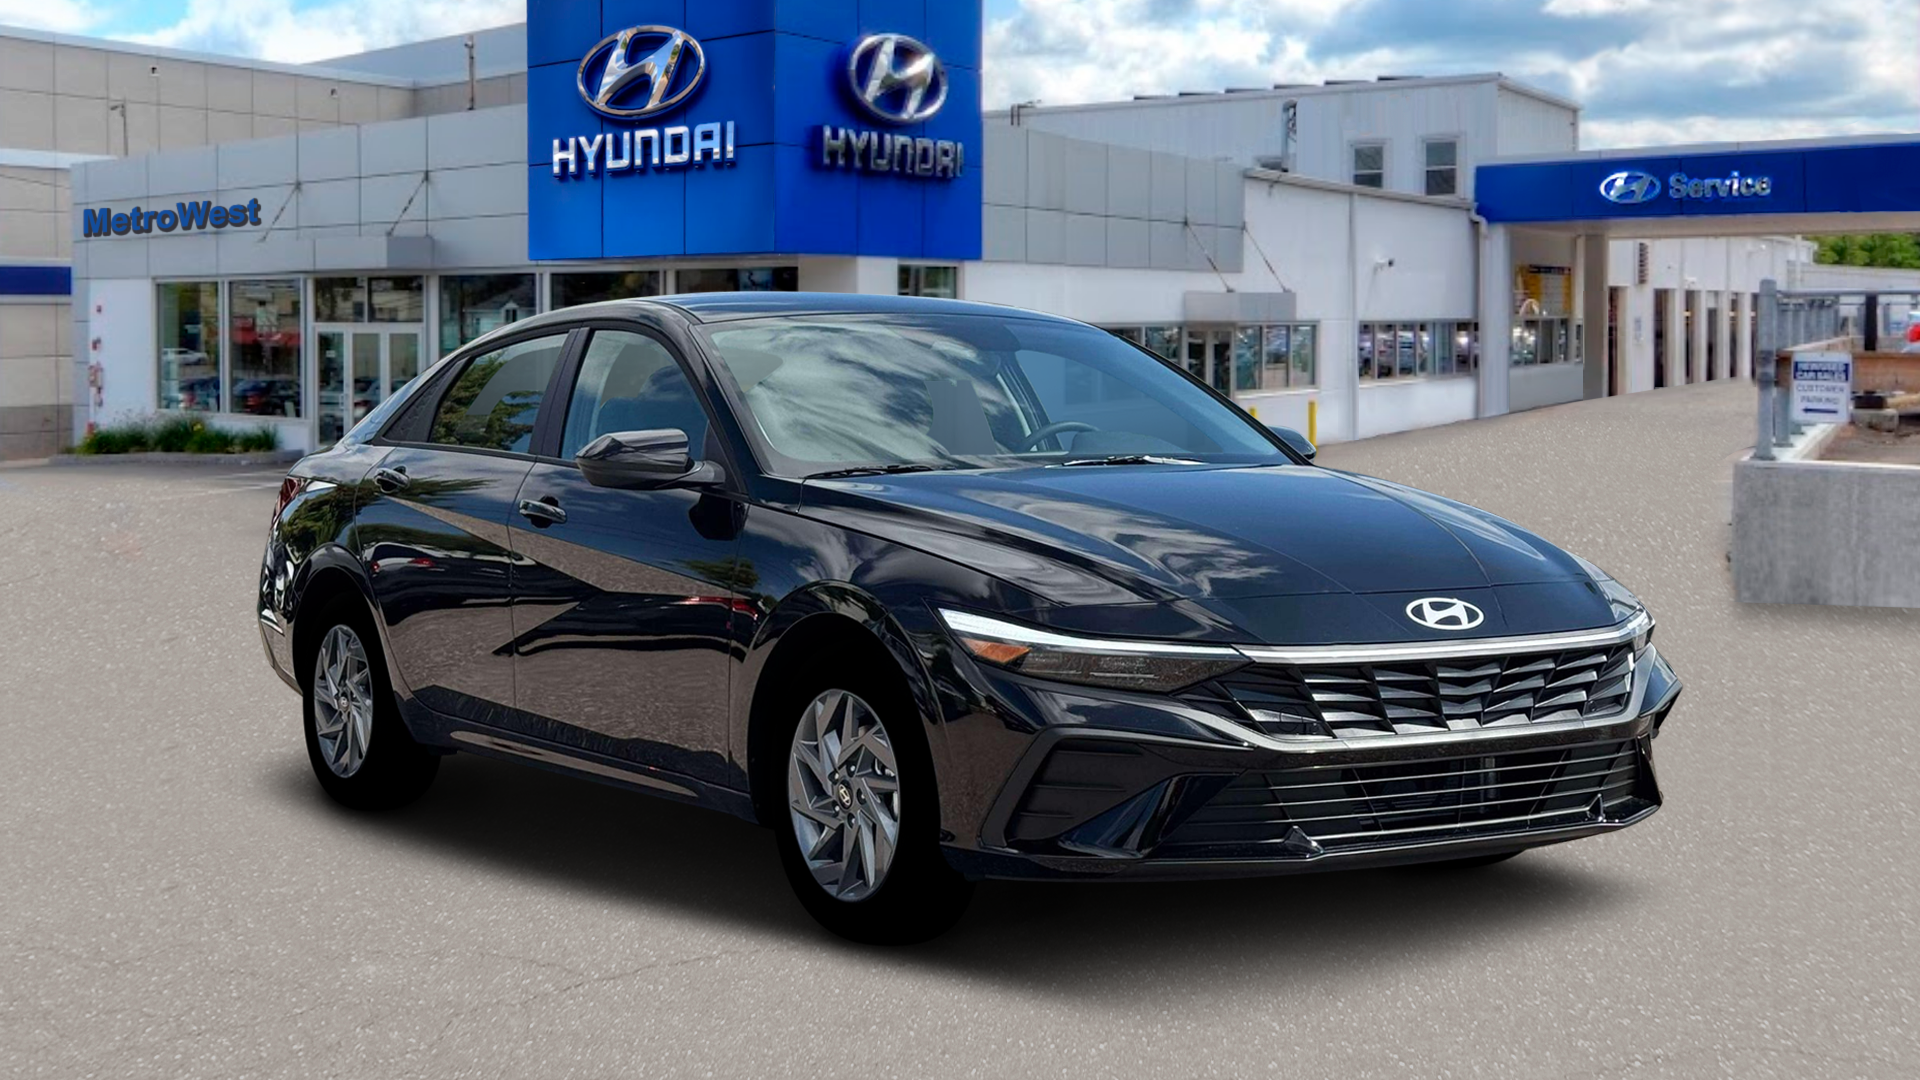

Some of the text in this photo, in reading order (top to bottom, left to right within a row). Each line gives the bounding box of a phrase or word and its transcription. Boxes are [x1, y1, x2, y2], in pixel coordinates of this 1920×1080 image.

[552, 120, 736, 178] HYUNDAI
[821, 125, 965, 179] HYUNDAI
[1669, 171, 1773, 199] Service
[83, 198, 262, 238] MetroWest
[1796, 384, 1845, 393] CUSTOMER
